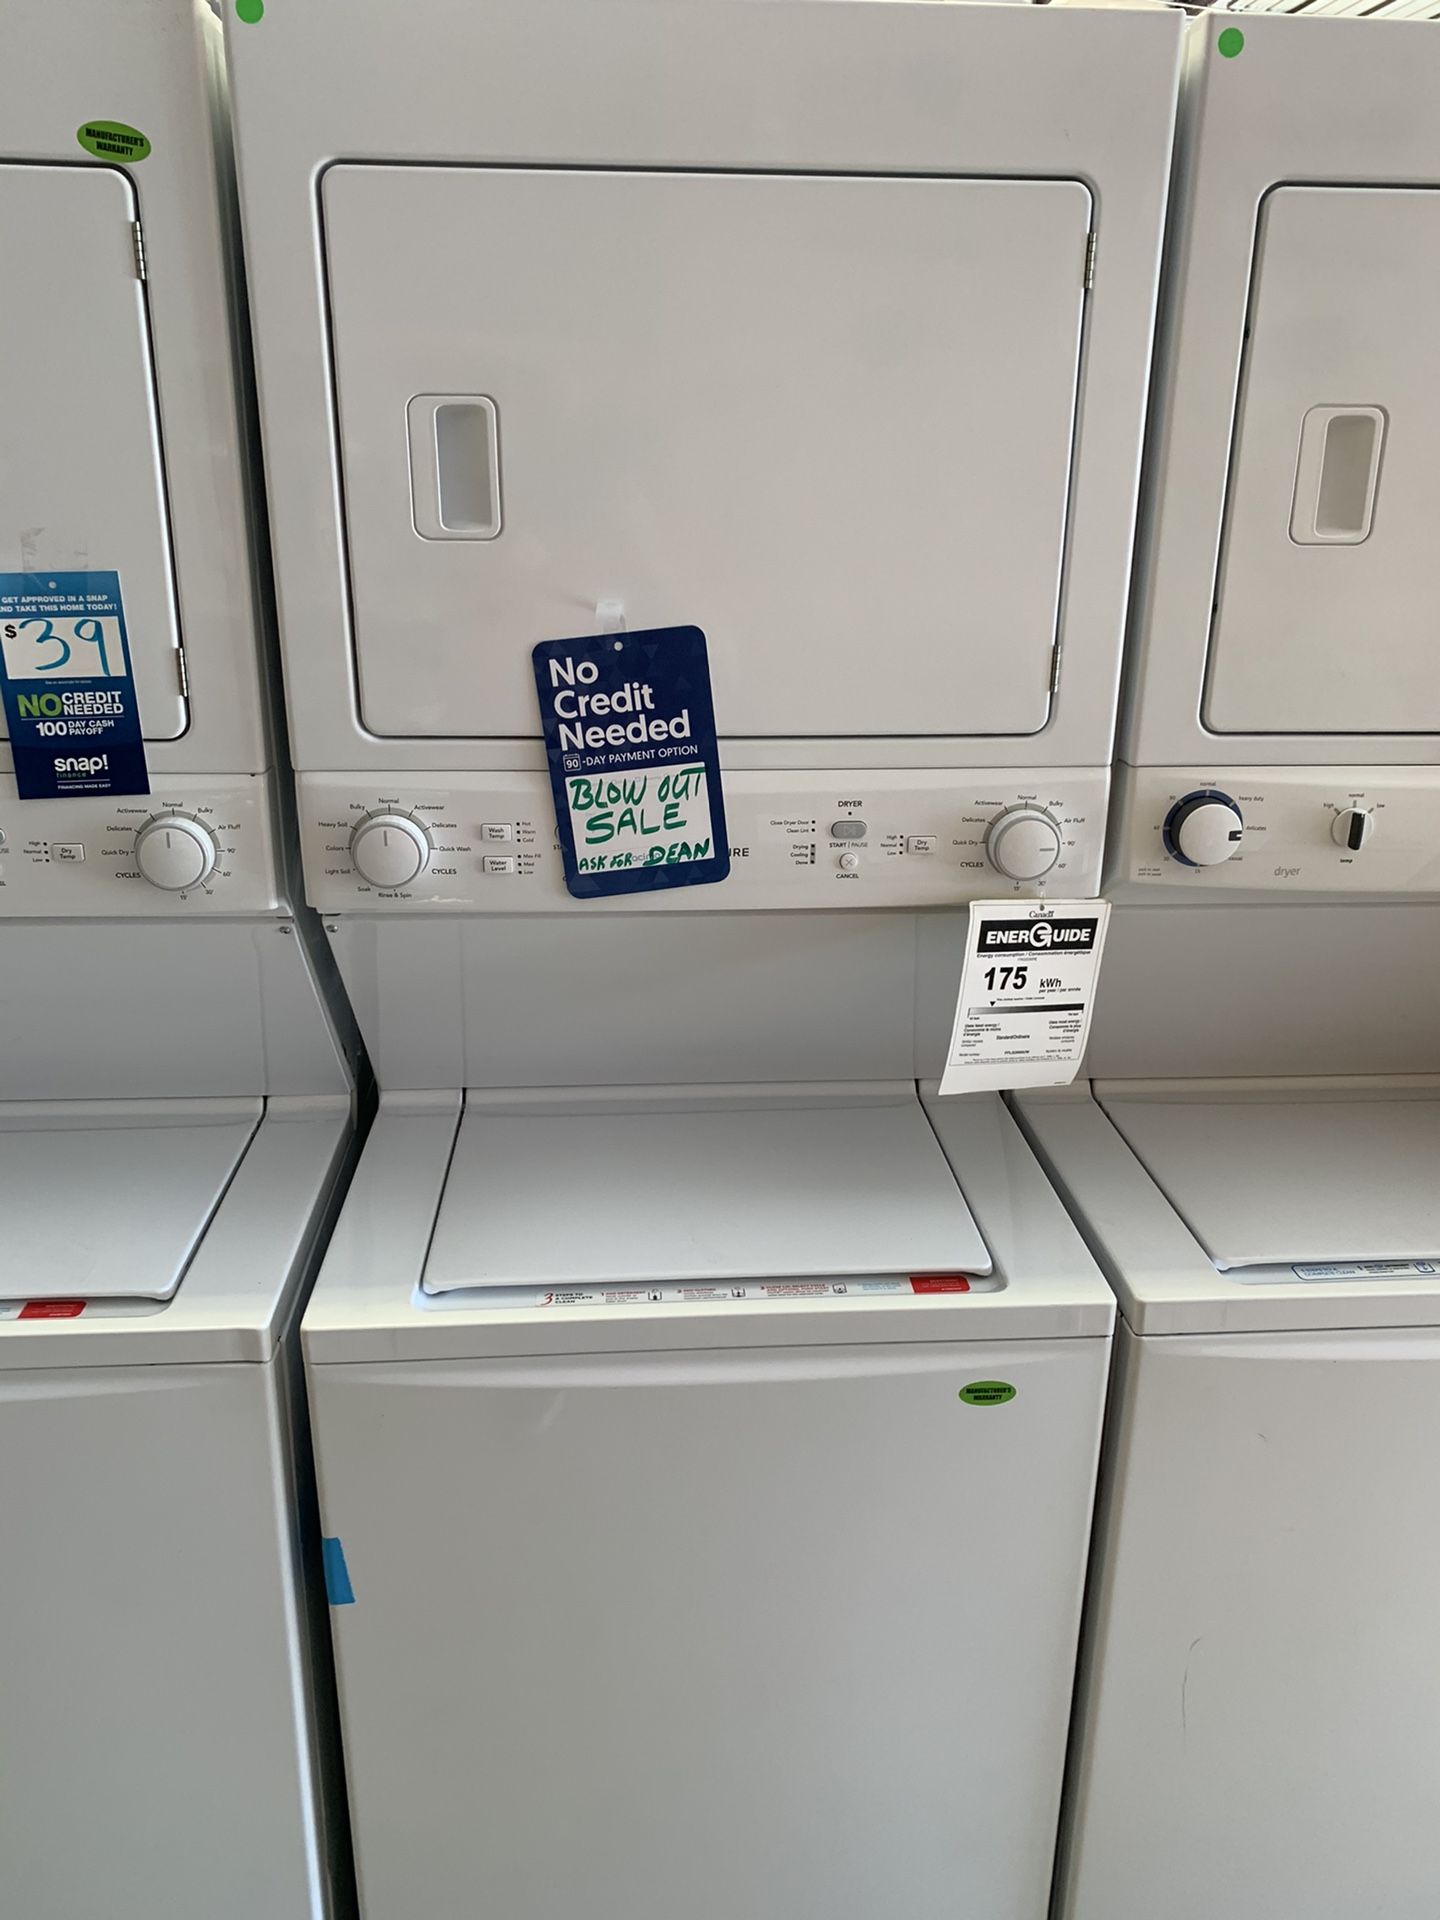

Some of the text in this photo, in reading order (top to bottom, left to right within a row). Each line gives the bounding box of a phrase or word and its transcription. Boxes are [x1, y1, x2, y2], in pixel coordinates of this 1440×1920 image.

[86, 128, 144, 147] MANUFACTURER'S
[96, 141, 134, 156] WARRANTY
[4, 618, 111, 677] $ 39
[549, 657, 599, 687] No
[17, 691, 122, 717] NO CREDIT
[63, 703, 124, 715] NEEDED
[554, 682, 655, 719] Credit
[36, 720, 114, 737] 100 DAY CASH
[69, 728, 104, 736] PAYOFF
[559, 709, 691, 751] Needed
[54, 754, 109, 775] snap!
[567, 759, 579, 768] 90
[609, 749, 656, 764] PAYMENT
[658, 745, 698, 758] OPTION
[569, 767, 705, 810] BLOW OUT
[585, 802, 687, 845] SALE
[579, 855, 607, 871] ASK
[643, 838, 710, 867] DEAN
[1274, 866, 1301, 879] dryer
[986, 922, 1091, 947] ENERGUIDE
[984, 967, 1028, 990] 175
[1040, 978, 1061, 988] kWh
[541, 1293, 553, 1305] 3
